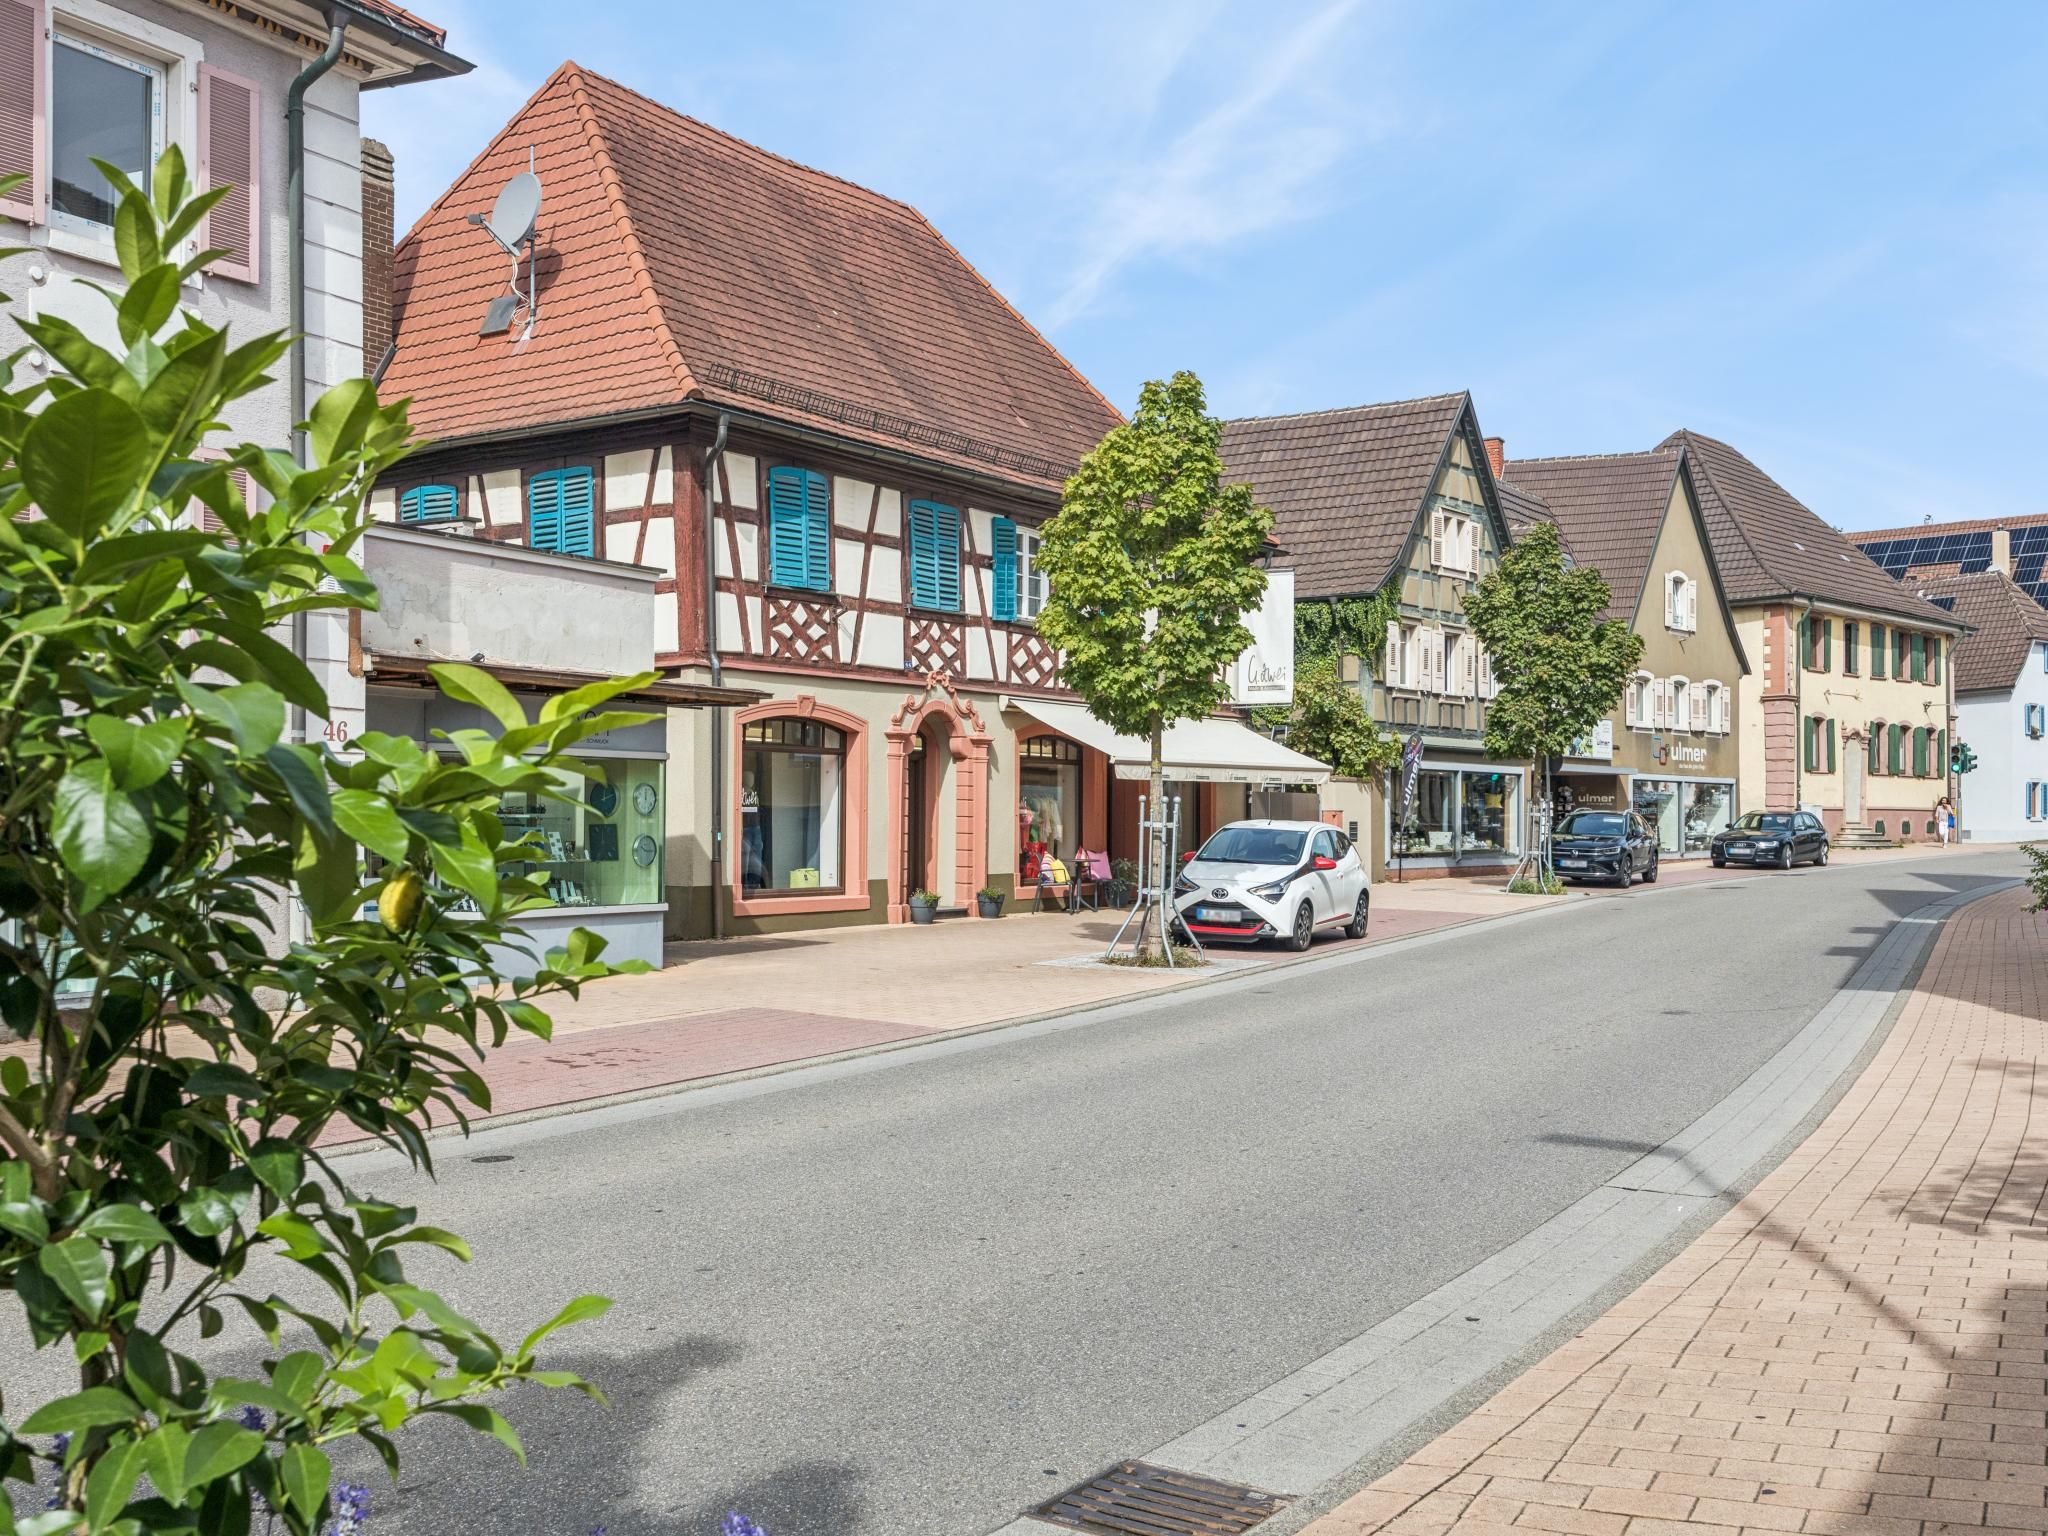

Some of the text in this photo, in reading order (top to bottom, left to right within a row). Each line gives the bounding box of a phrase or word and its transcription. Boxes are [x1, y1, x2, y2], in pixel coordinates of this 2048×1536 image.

[323, 720, 348, 742] 46
[1671, 741, 1707, 762] ulmer
[1403, 753, 1421, 806] ulmer
[1578, 793, 1616, 802] ulmer
